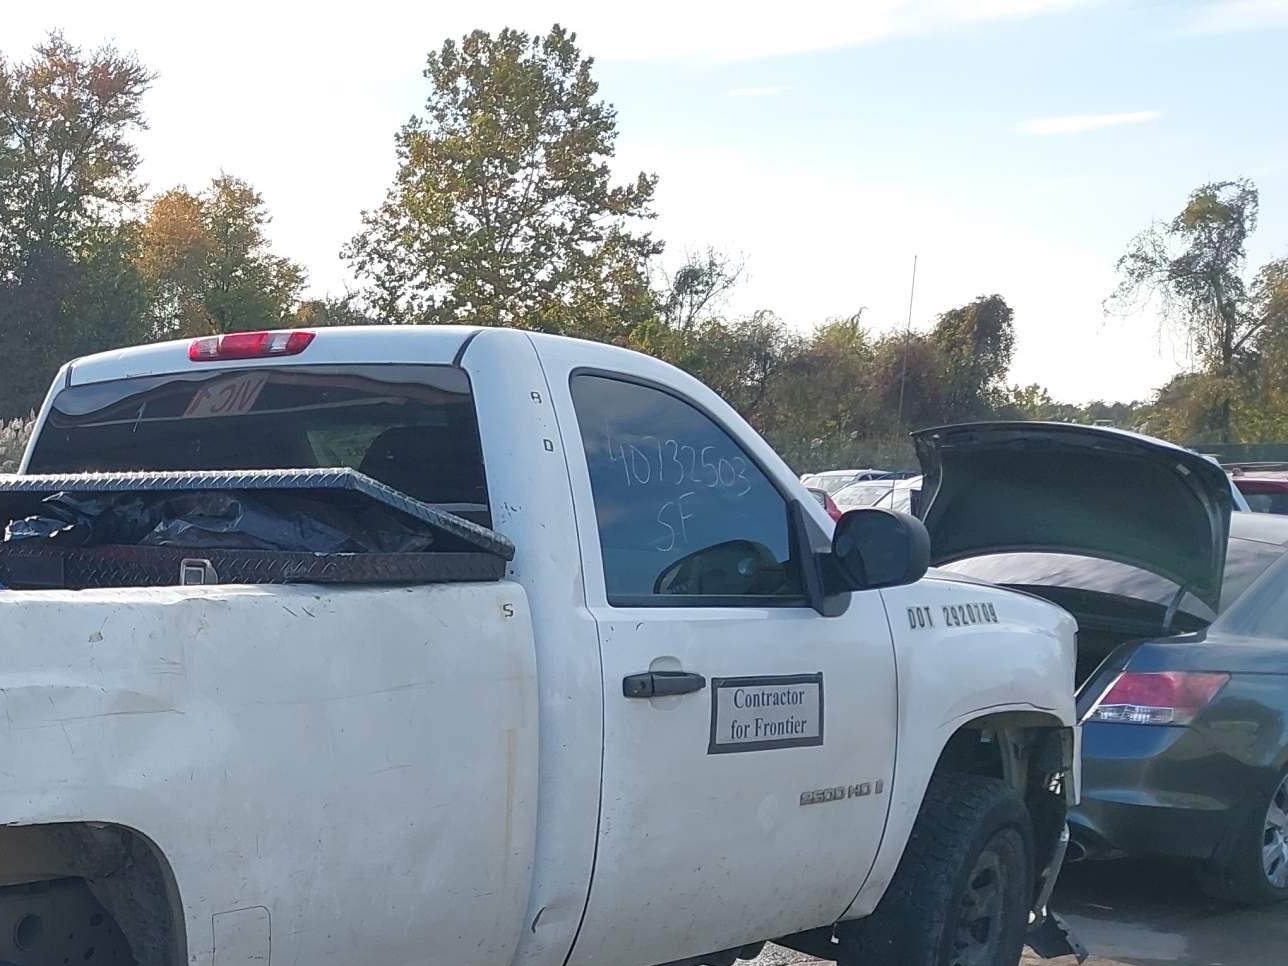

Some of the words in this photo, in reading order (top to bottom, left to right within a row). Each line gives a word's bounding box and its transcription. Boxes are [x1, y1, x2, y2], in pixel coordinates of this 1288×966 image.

[607, 433, 752, 497] 40732503
[656, 491, 696, 552] SF
[906, 606, 933, 629] DOT
[942, 602, 999, 626] 2920709
[733, 688, 806, 709] Contractor
[730, 719, 751, 740] for
[754, 715, 808, 738] Frontier
[799, 785, 846, 806] 2500
